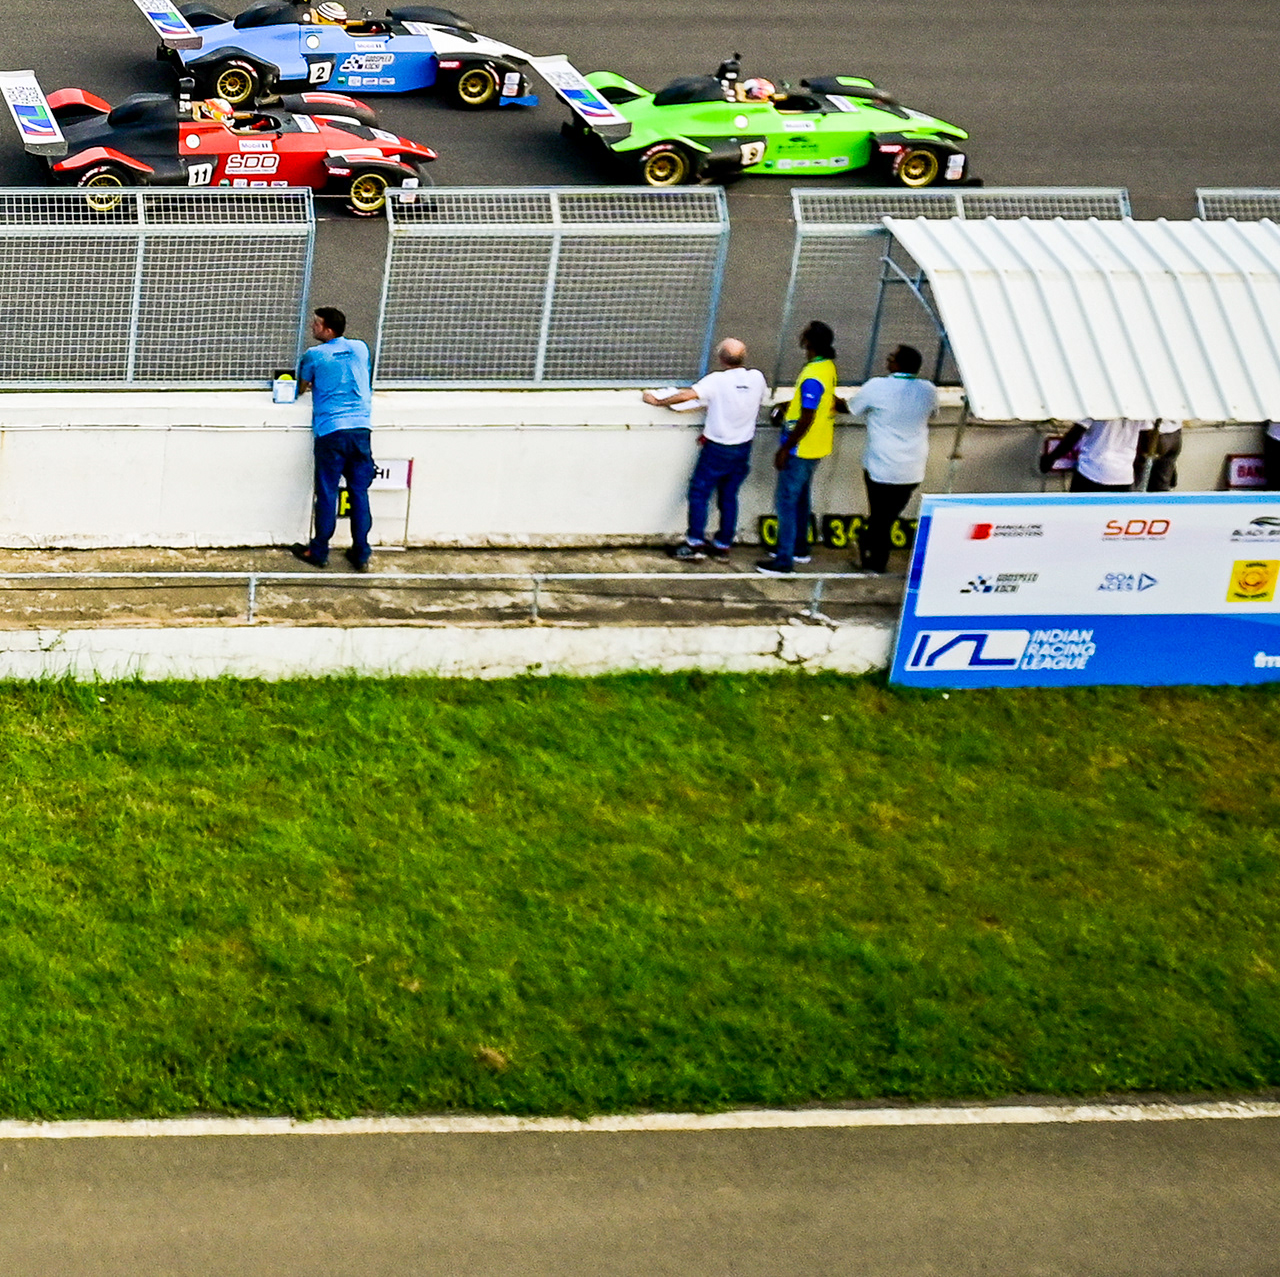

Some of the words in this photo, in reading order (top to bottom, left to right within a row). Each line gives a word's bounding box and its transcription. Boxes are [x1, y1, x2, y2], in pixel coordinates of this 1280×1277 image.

[315, 66, 325, 80] 2
[228, 155, 278, 168] SDD
[194, 168, 209, 183] 11
[889, 519, 907, 548] 6
[1104, 519, 1171, 536] SDD
[1031, 629, 1094, 644] INDIAN
[1026, 642, 1097, 657] RACING
[1021, 655, 1091, 670] LEAGUE
